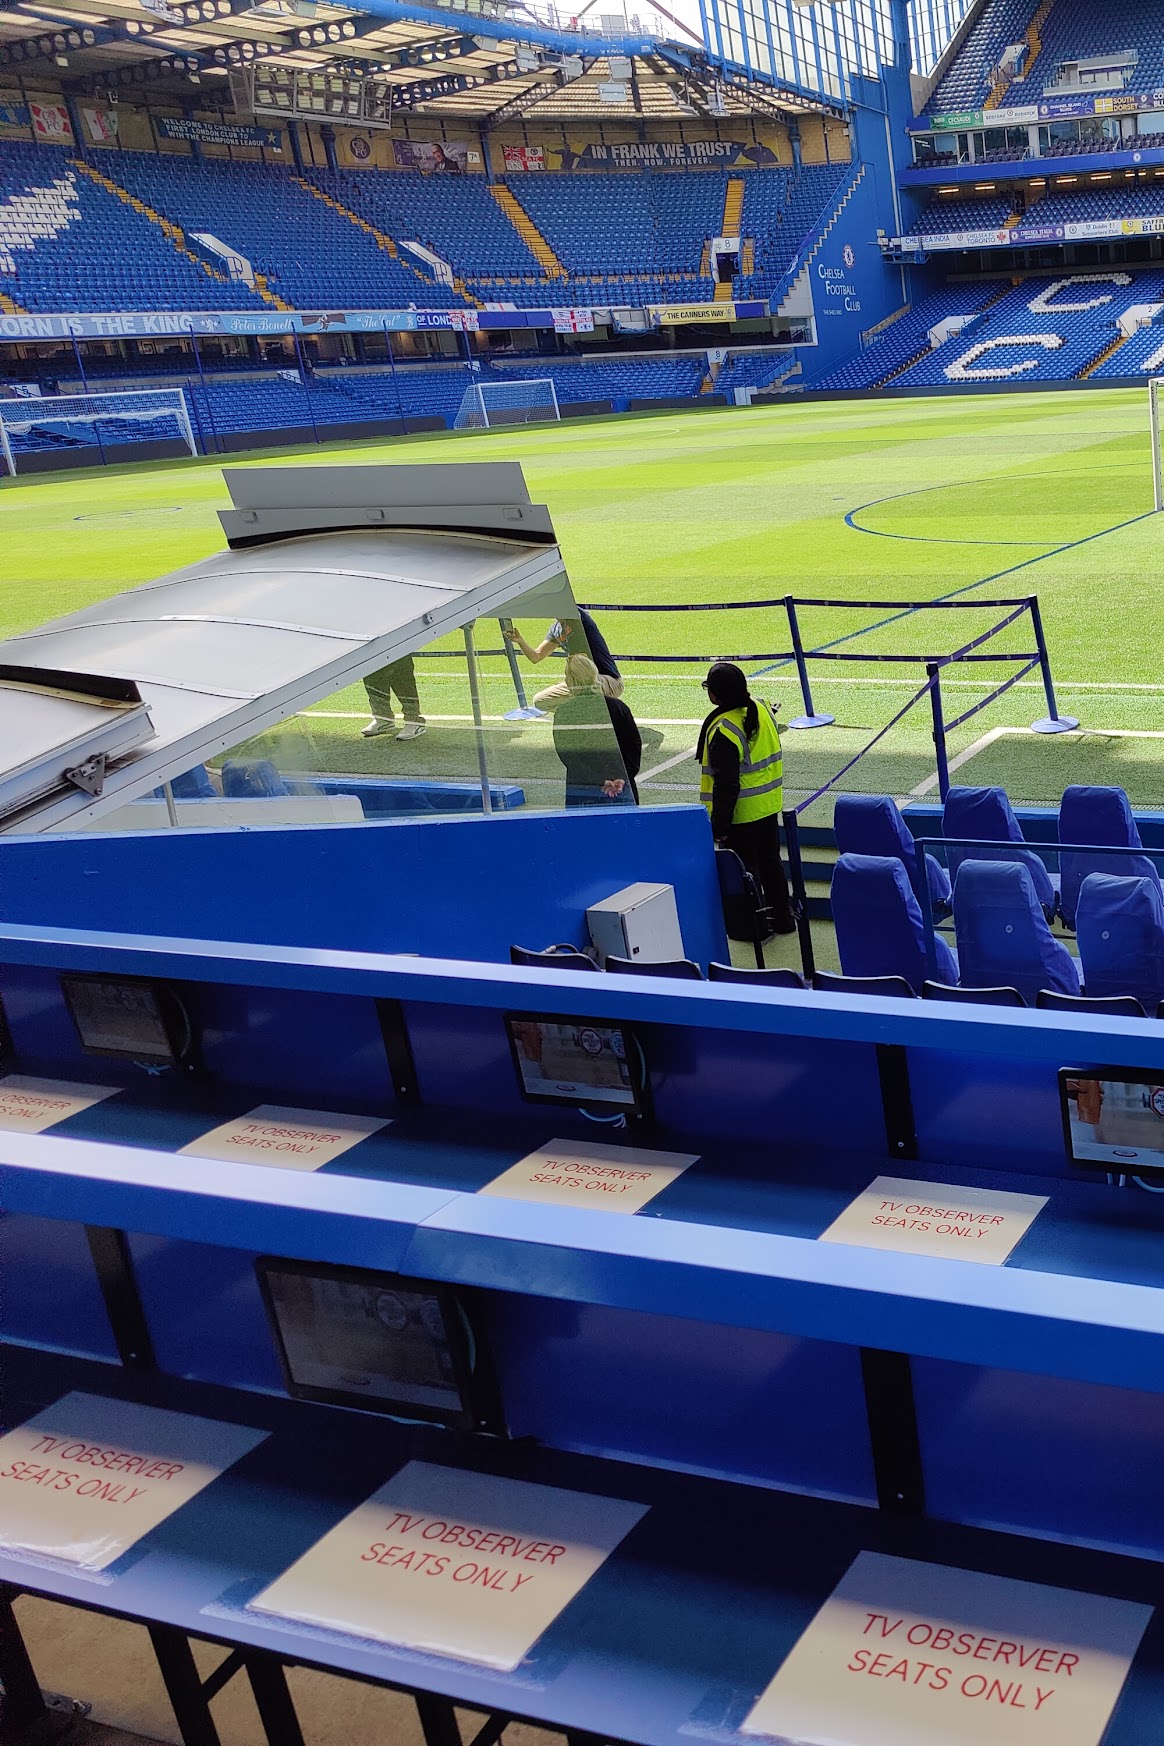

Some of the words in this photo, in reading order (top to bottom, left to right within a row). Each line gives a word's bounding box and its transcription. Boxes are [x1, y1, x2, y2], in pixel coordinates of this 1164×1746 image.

[1114, 103, 1138, 112] DORSET
[161, 118, 202, 128] WELCOME
[192, 128, 220, 136] LONDON
[201, 135, 240, 146] CHAMPIONS
[592, 144, 606, 159] IN
[611, 144, 658, 159] FRANK
[662, 144, 685, 158] WE
[687, 142, 732, 157] TRUST
[614, 159, 640, 167] THEN.
[644, 158, 666, 166] NOW.
[670, 157, 712, 166] FOREVER.
[724, 240, 730, 249] 8
[818, 264, 845, 279] CHELSEA
[825, 281, 856, 295] FOOTBALL
[844, 297, 861, 311] CLUB
[416, 316, 427, 326] OF
[680, 310, 710, 319] CANNERS
[0, 318, 54, 336] ORN
[60, 317, 84, 336] IS
[92, 316, 138, 335] THE
[143, 314, 194, 334] KING
[230, 318, 257, 330] Peter
[2, 1094, 72, 1110] OBSERVER
[10, 1108, 48, 1118] ONLY
[243, 1124, 265, 1133] TV
[262, 1127, 342, 1144] OBSERVER
[226, 1135, 276, 1148] SEATS
[275, 1142, 320, 1153] ONLY
[542, 1160, 566, 1170] TV
[564, 1163, 652, 1181] OBSERVER
[529, 1173, 583, 1187] SEATS
[585, 1180, 632, 1193] ONLY
[880, 1201, 903, 1211] TV
[905, 1204, 1005, 1226] OBSERVER
[871, 1216, 931, 1231] SEATS
[936, 1224, 989, 1238] ONLY
[30, 1435, 63, 1454] TV
[61, 1443, 185, 1481] OBSERVER
[0, 1460, 76, 1492] SEATS
[77, 1477, 149, 1506] ONLY
[386, 1512, 424, 1534] TV
[423, 1521, 567, 1565] OBSERVER
[361, 1541, 447, 1576] SEATS
[452, 1559, 534, 1593] ONLY
[863, 1613, 902, 1638] TV
[906, 1623, 1081, 1677] OBSERVER
[847, 1649, 954, 1692] SEATS
[960, 1673, 1056, 1713] ONLY
